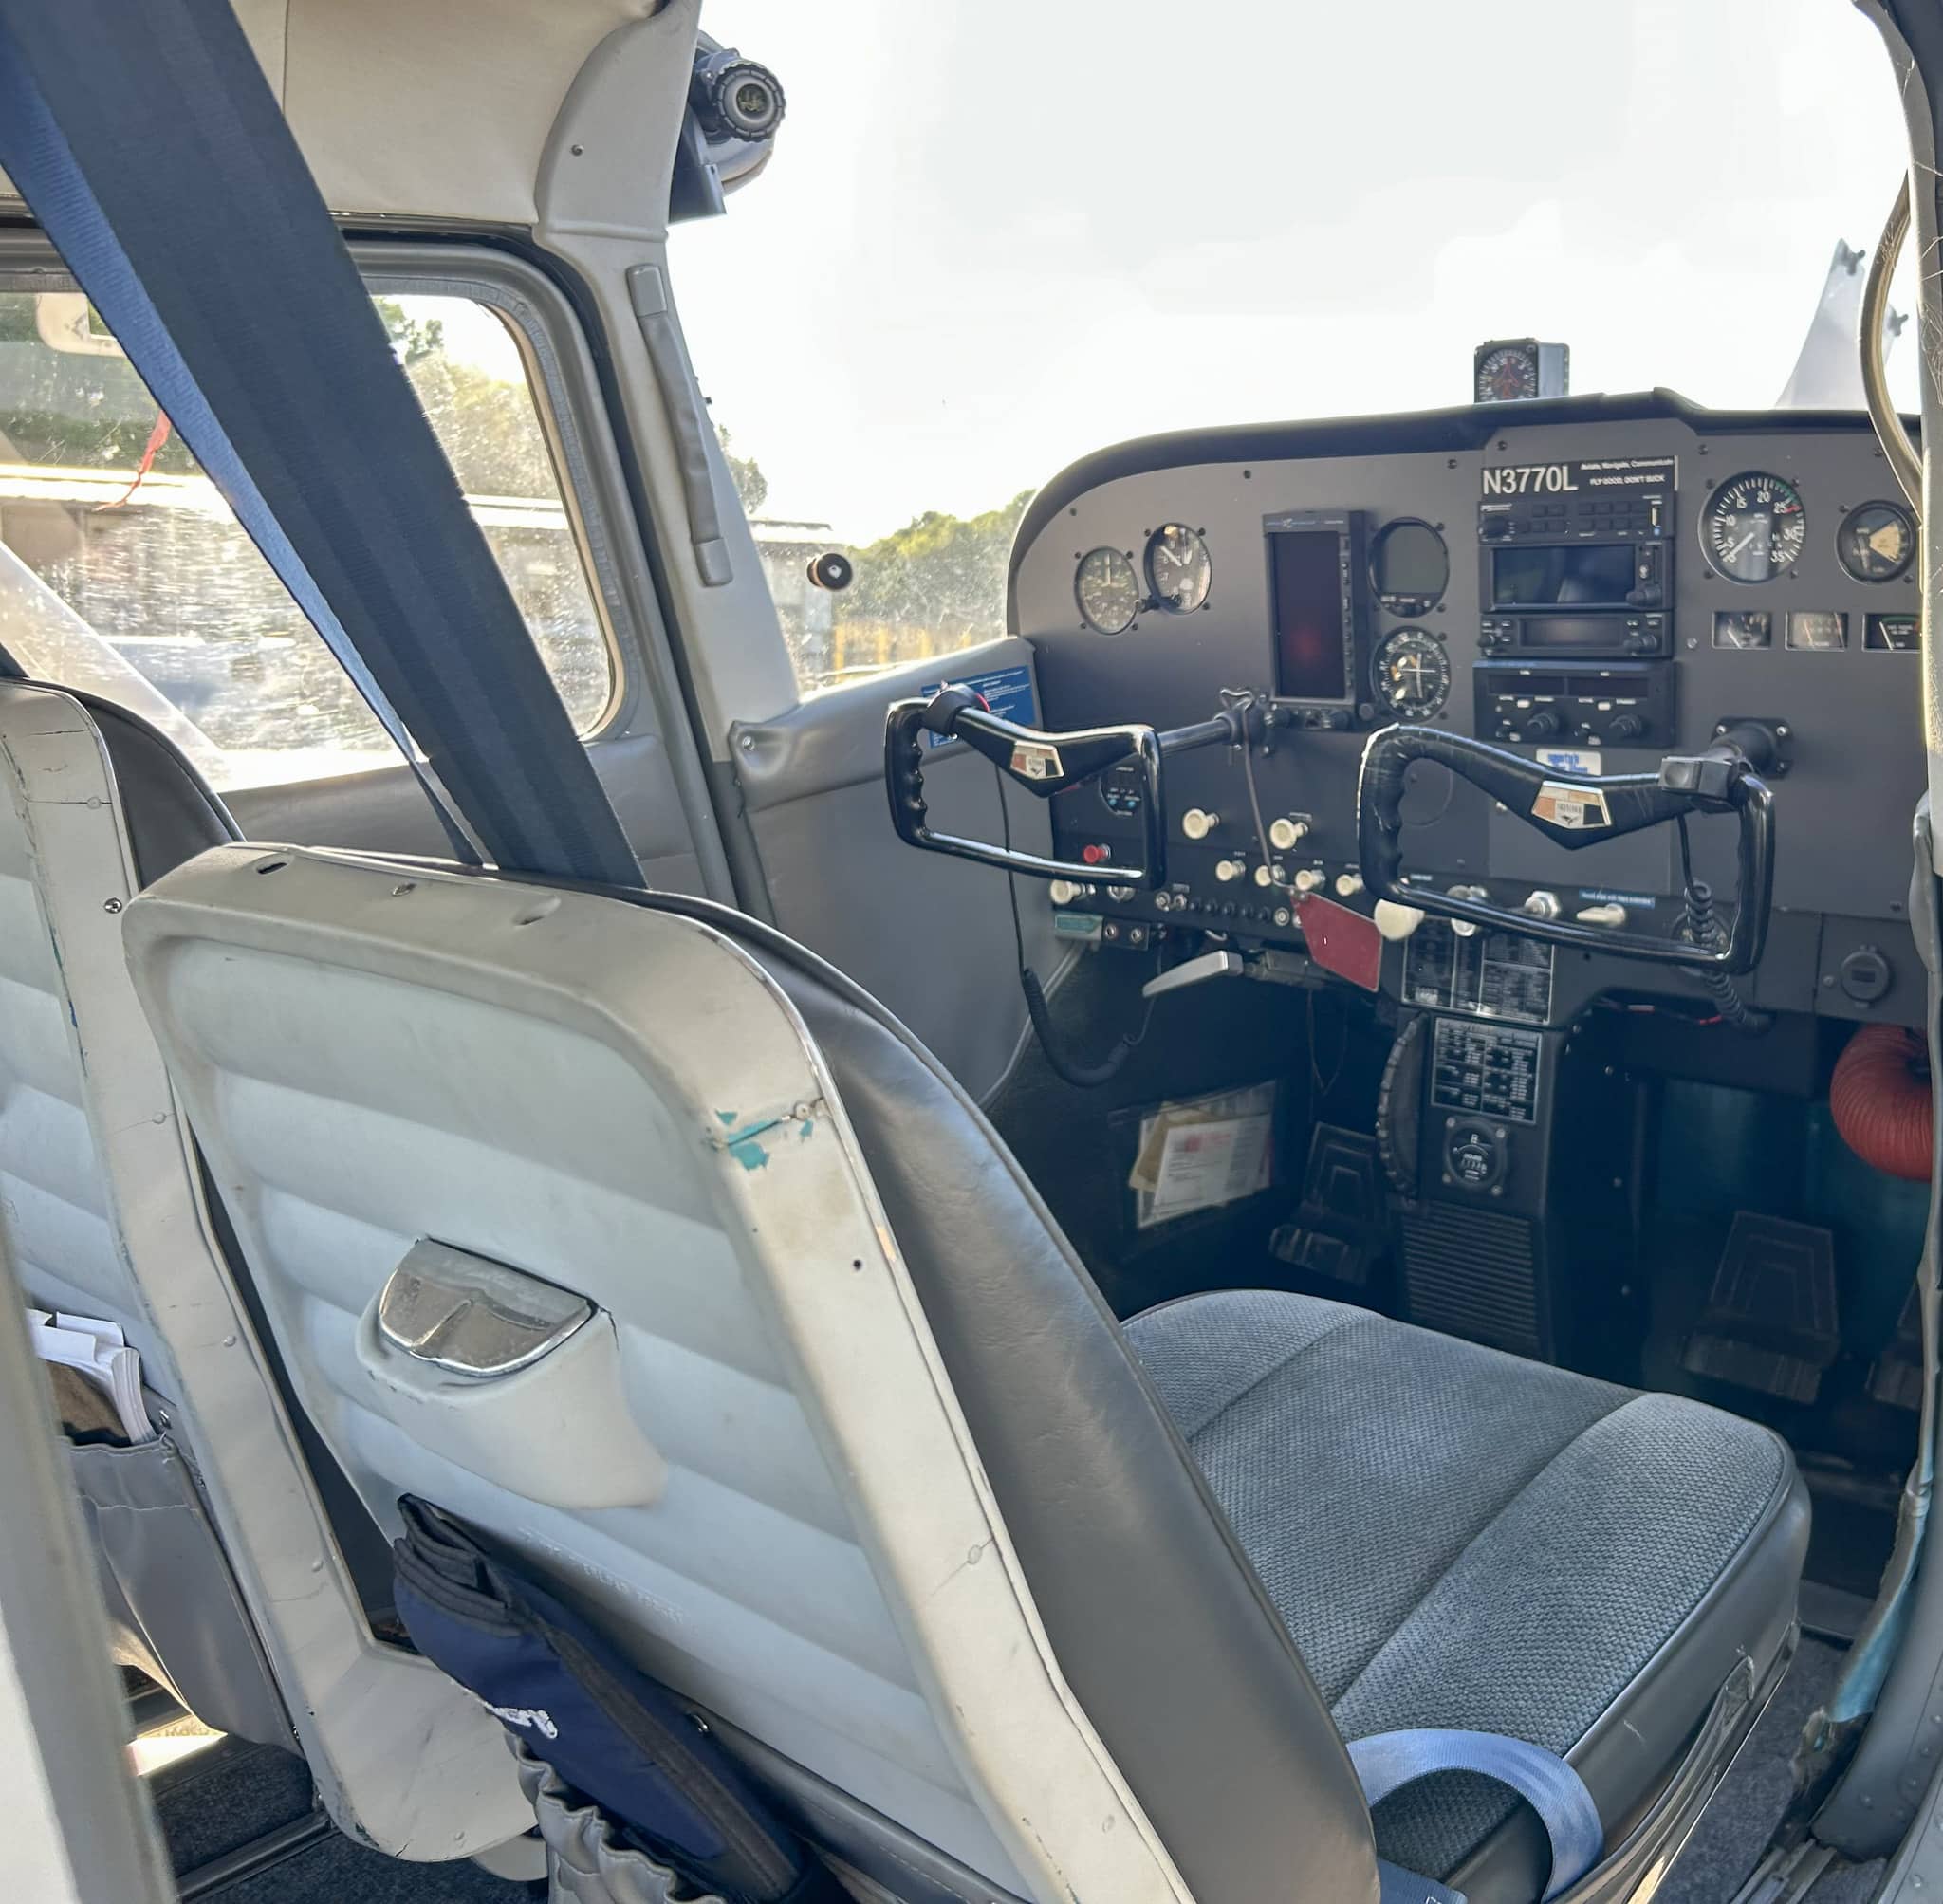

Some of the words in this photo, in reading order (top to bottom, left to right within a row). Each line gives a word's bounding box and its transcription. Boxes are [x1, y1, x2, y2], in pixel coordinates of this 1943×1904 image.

[1483, 465, 1579, 495] N3770L
[1757, 491, 1771, 504] 20
[1773, 500, 1788, 514] 25
[1770, 550, 1785, 563] 35
